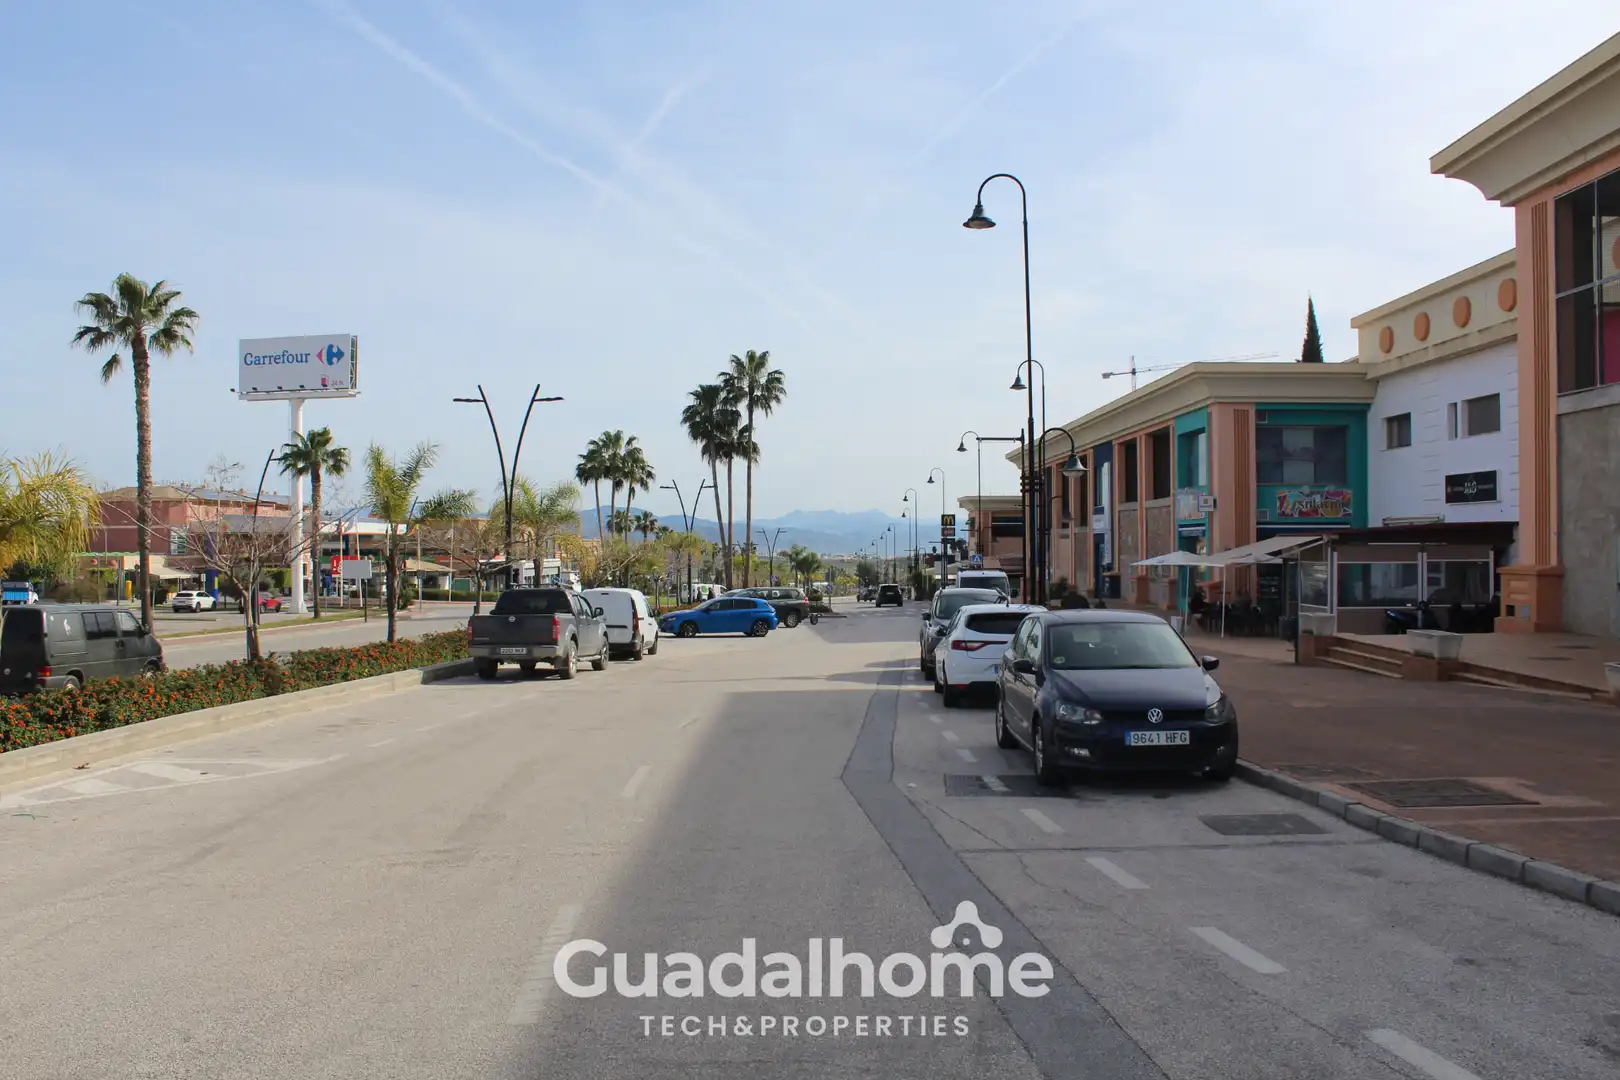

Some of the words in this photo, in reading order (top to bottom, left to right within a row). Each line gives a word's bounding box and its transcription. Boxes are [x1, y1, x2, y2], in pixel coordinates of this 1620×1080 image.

[243, 349, 311, 366] Carrefour
[1132, 733, 1160, 744] 9641
[1165, 732, 1187, 743] HFG
